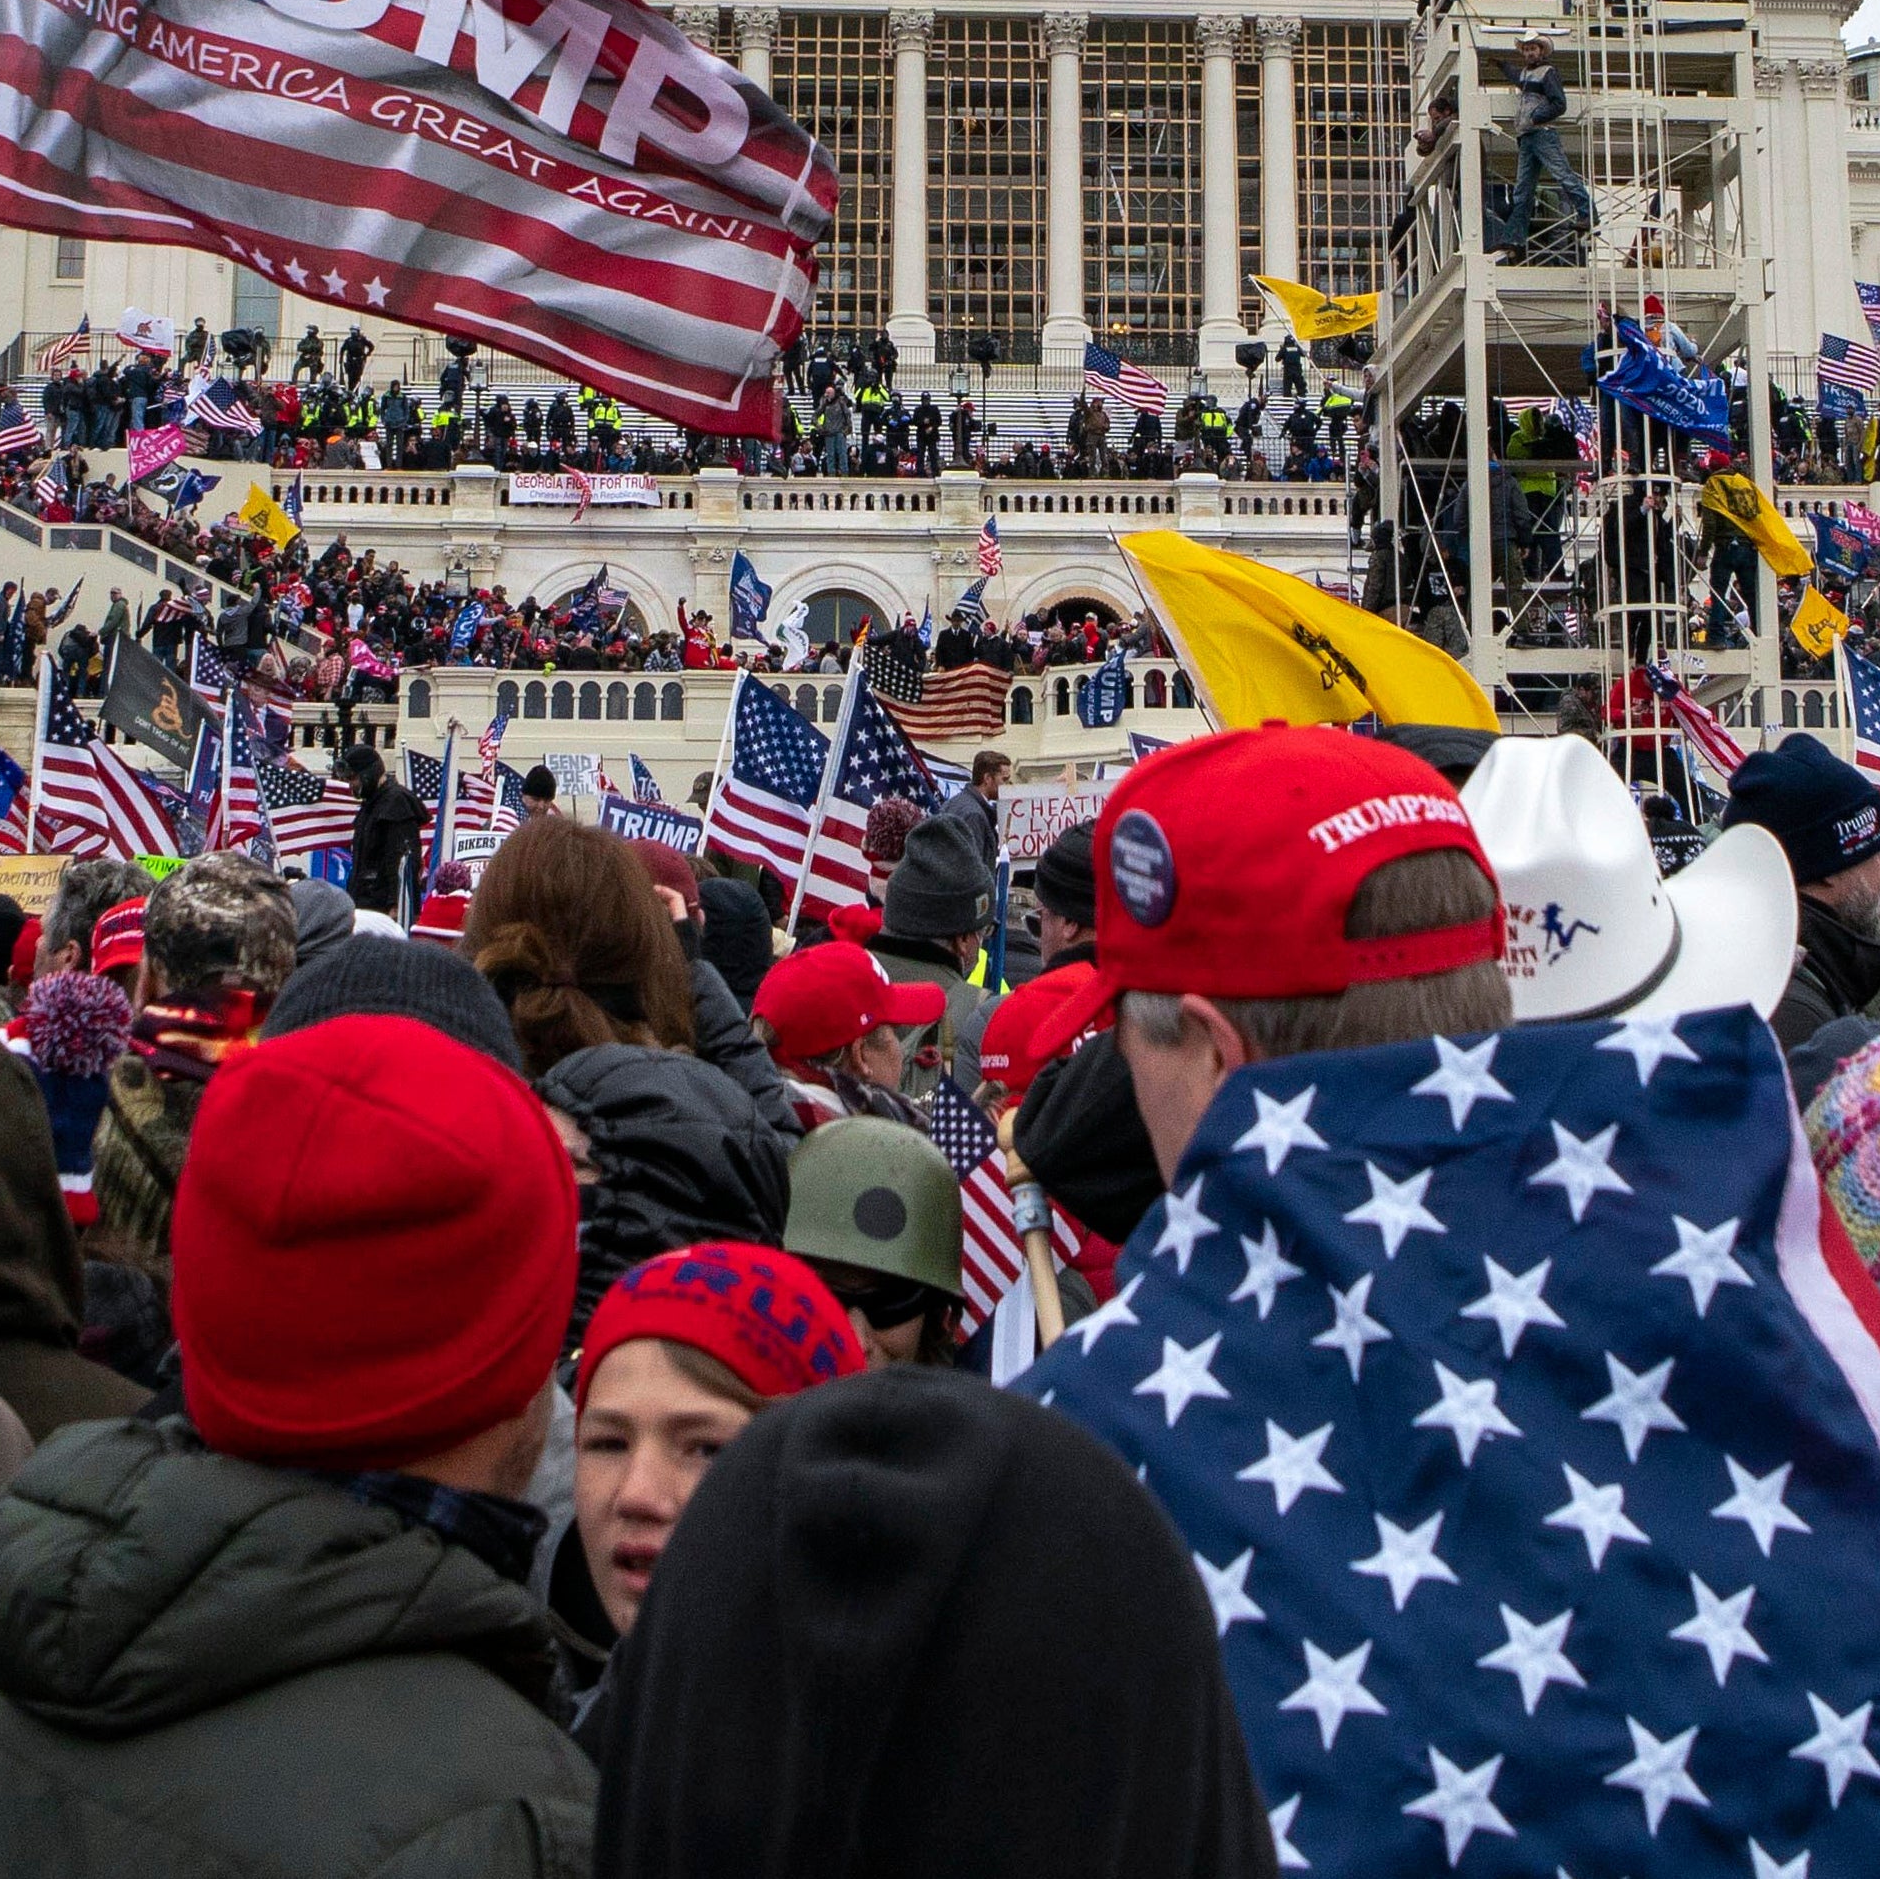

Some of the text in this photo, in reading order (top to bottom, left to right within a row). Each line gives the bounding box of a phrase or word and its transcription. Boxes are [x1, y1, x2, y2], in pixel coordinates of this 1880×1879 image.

[147, 20, 350, 114] AMERICA
[369, 90, 559, 181] GREAT
[566, 173, 756, 245] AGAIN!
[515, 475, 563, 489] GEORGIA
[600, 477, 622, 490] FOR
[549, 754, 593, 770] SEND
[560, 783, 593, 795] JAIL
[1833, 805, 1878, 836] Trump
[608, 808, 702, 853] TRUMP
[457, 836, 497, 853] BIKERS
